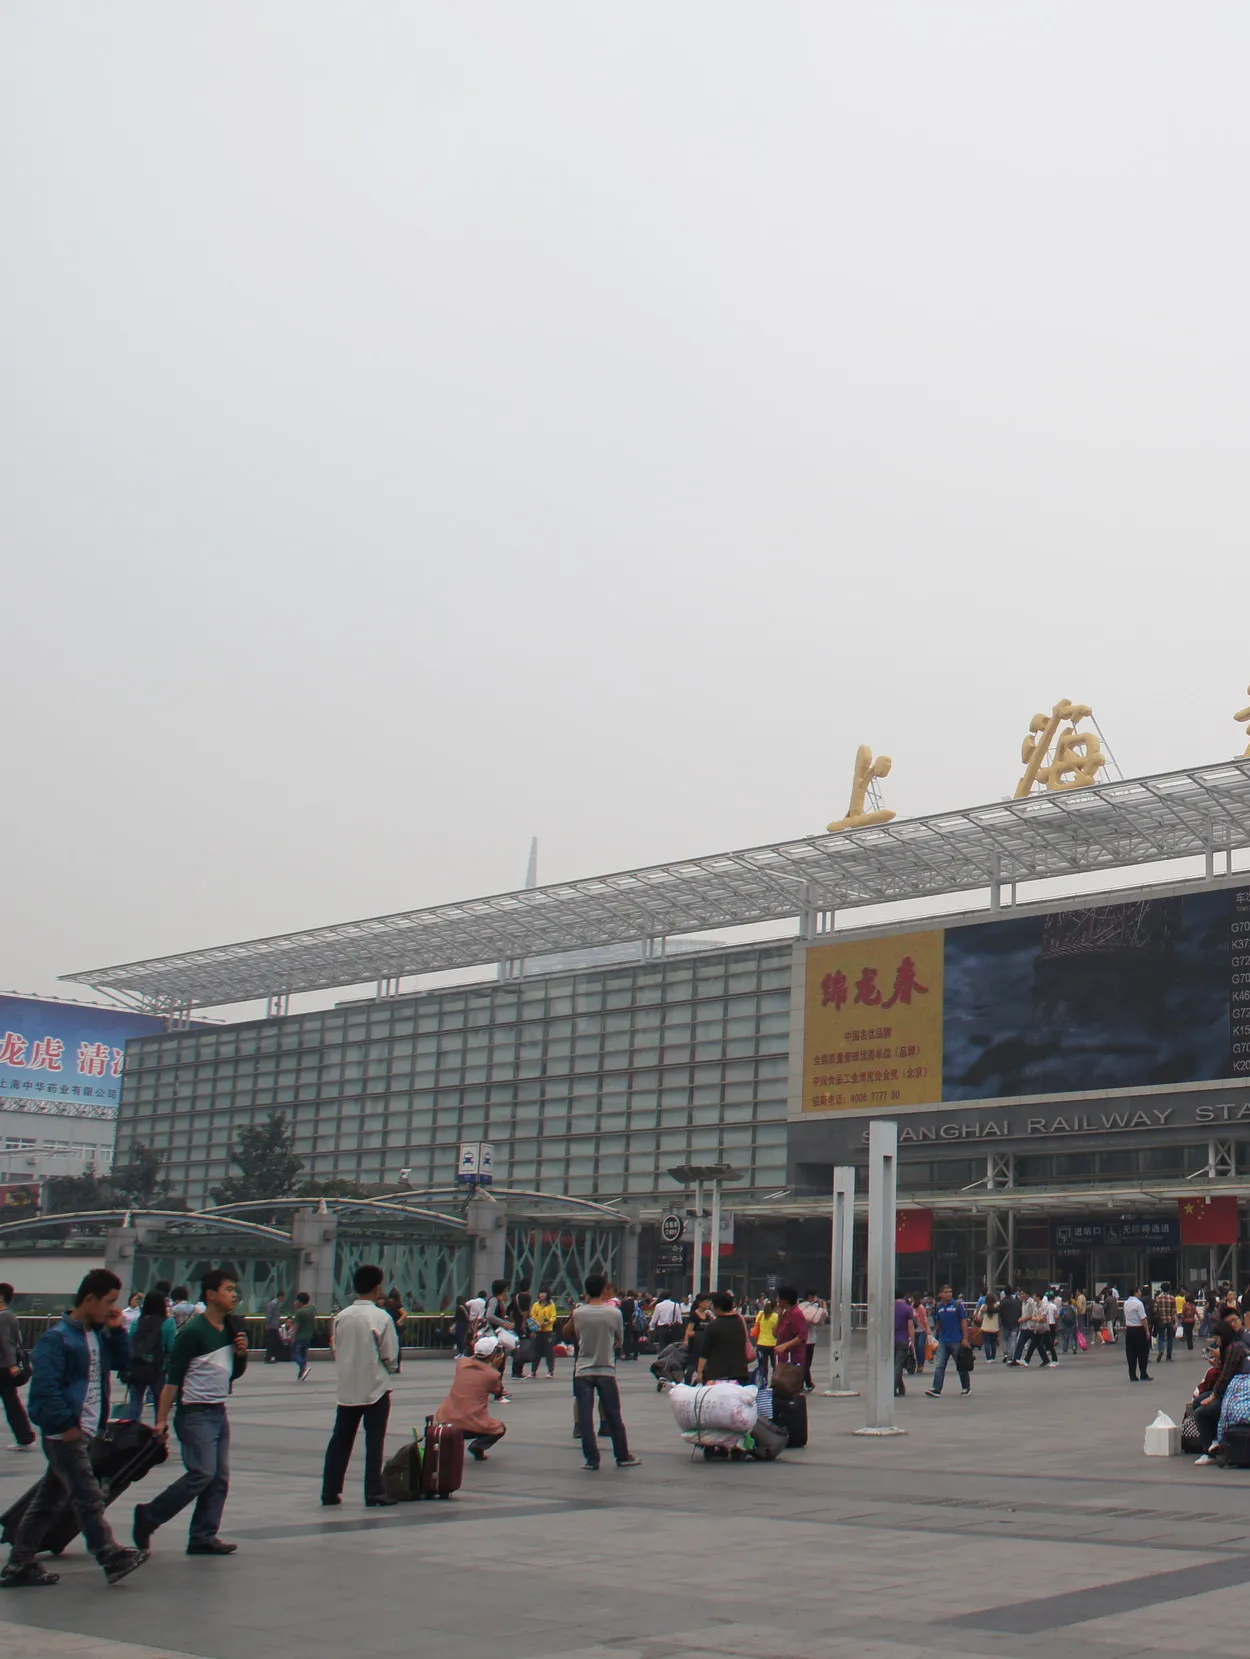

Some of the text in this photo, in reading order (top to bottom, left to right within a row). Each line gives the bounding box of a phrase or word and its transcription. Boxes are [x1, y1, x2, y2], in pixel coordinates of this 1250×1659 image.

[0, 1031, 65, 1071] 龙虎
[0, 1079, 117, 1099] 上海中华药业有限公司
[862, 1121, 1009, 1144] ANGHAI
[1028, 1108, 1173, 1134] RAILWAY
